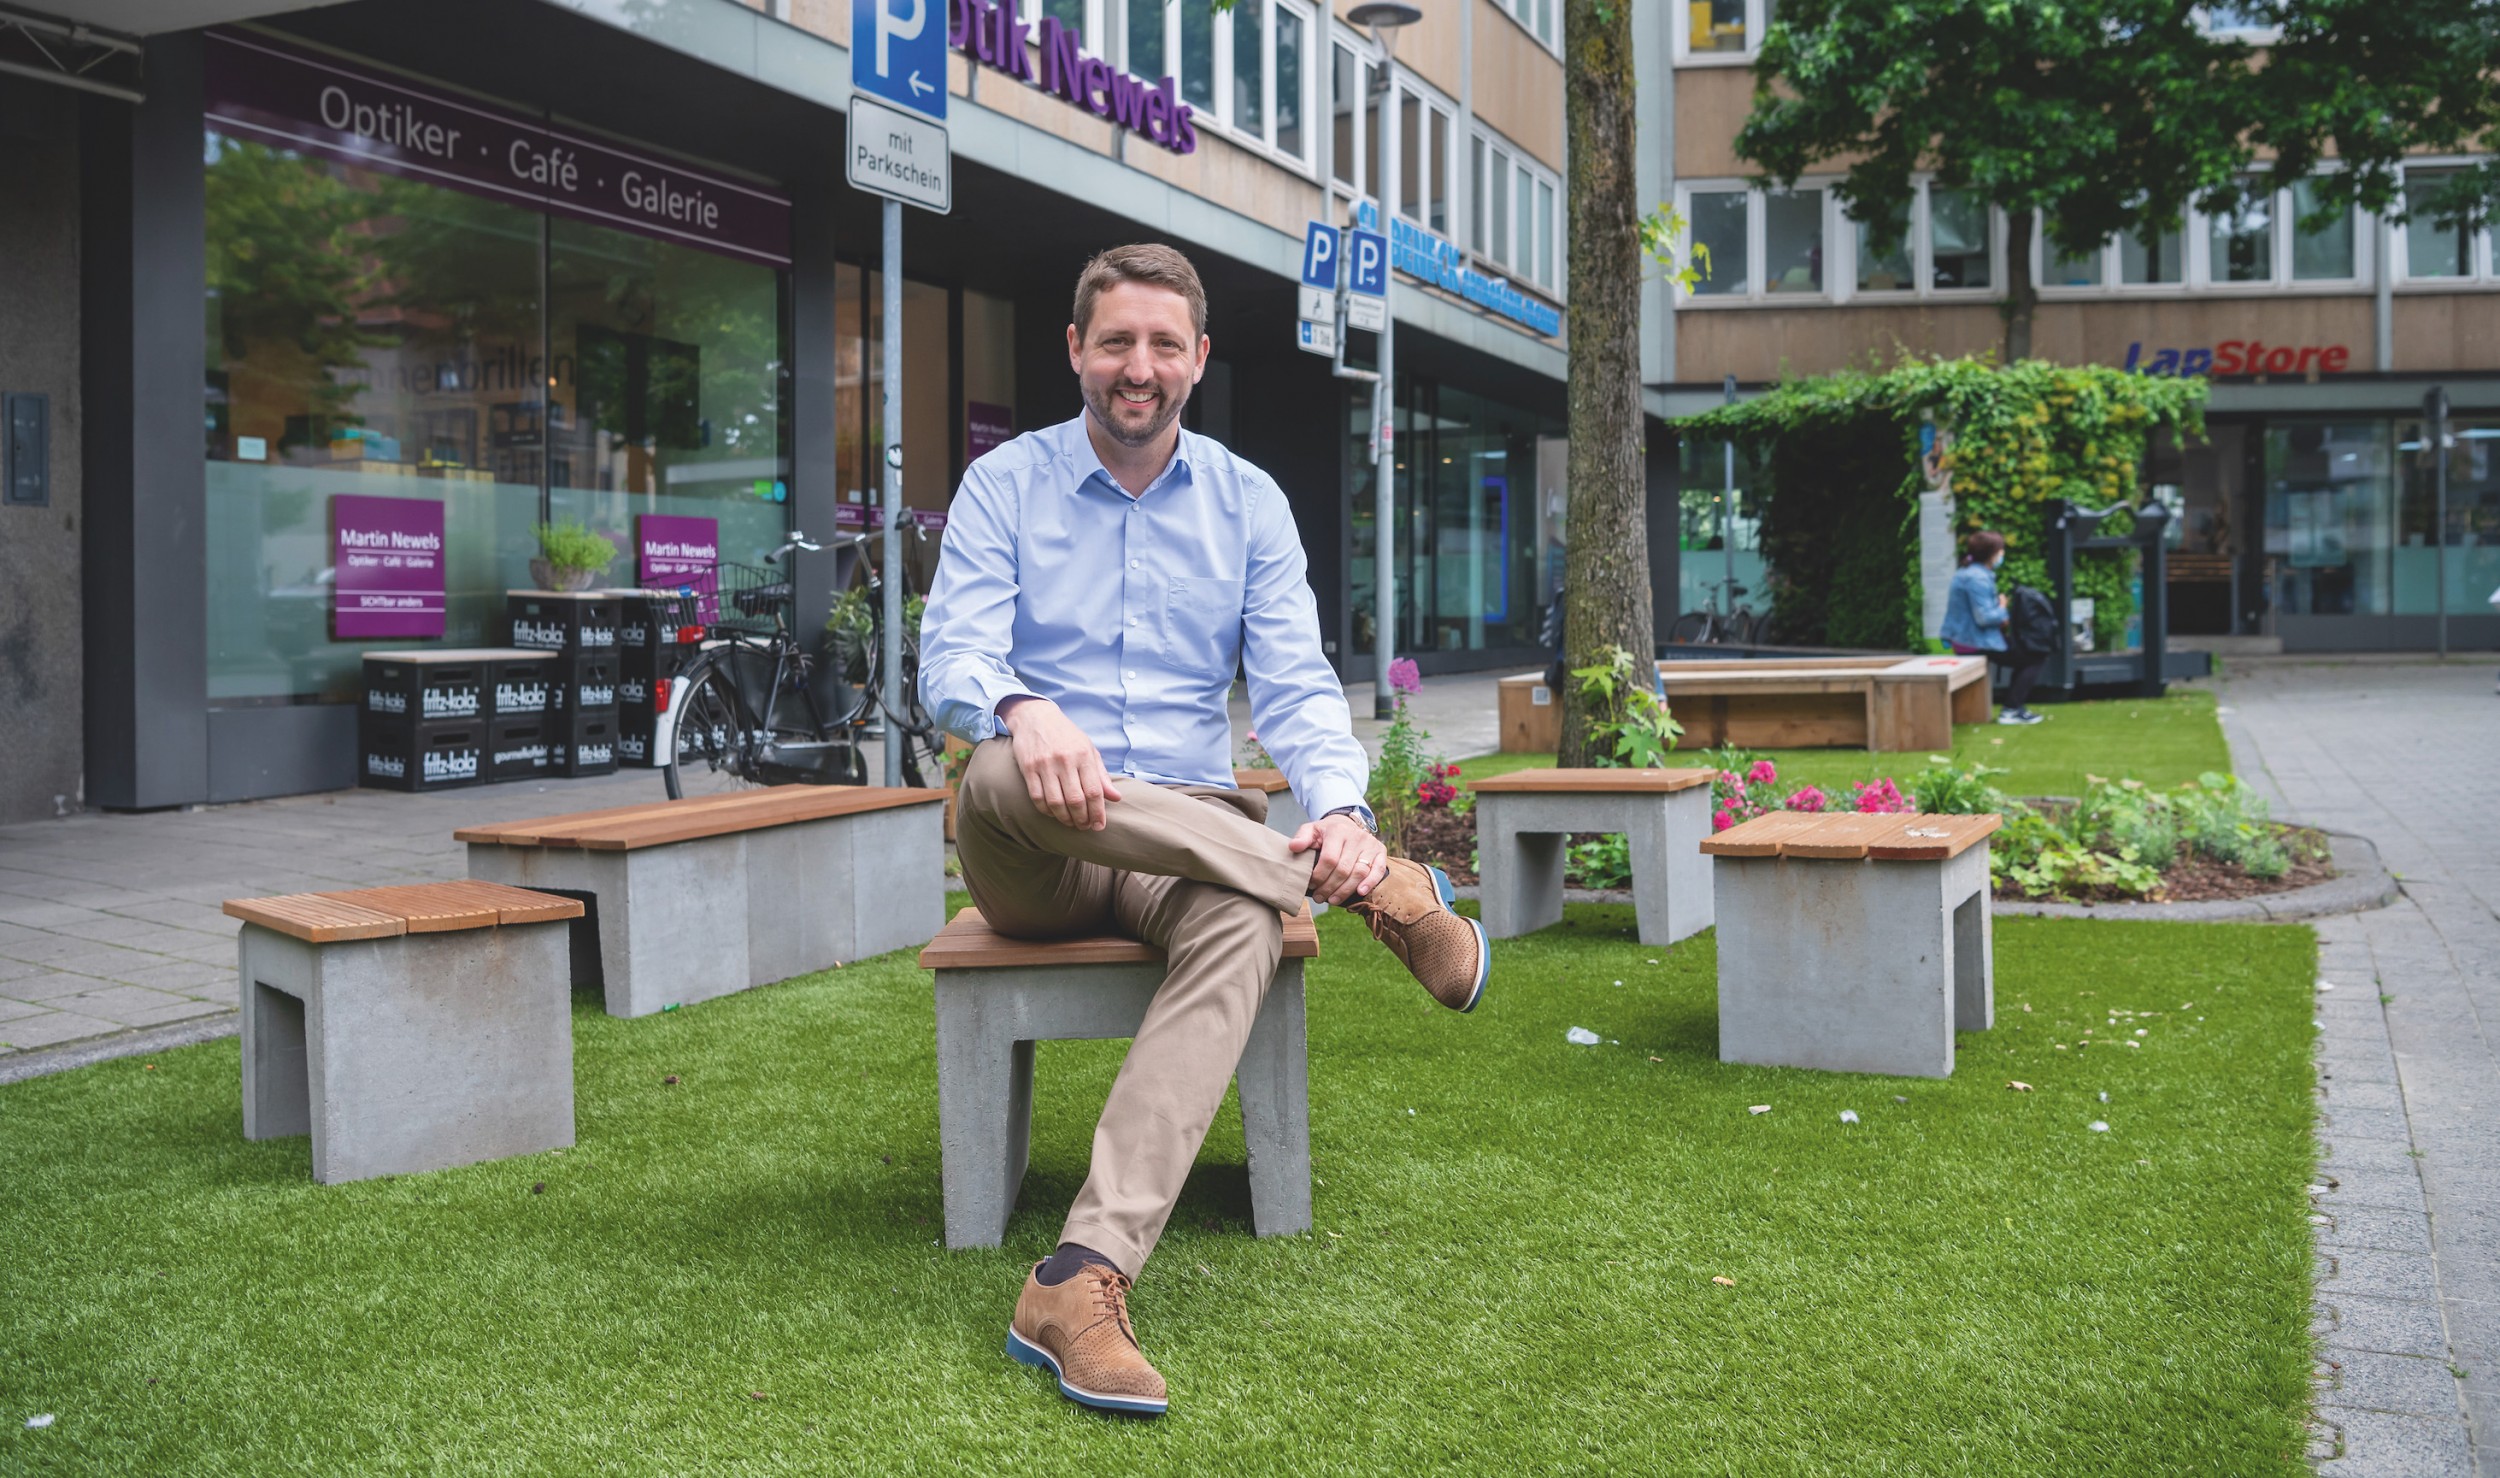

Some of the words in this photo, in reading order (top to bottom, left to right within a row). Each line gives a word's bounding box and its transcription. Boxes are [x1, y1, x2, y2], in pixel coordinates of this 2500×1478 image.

[1040, 15, 1196, 155] Newels
[889, 131, 912, 154] mit
[320, 86, 460, 160] Optiker
[509, 140, 578, 192] Café
[621, 171, 719, 229] Galerie
[857, 146, 942, 192] Parkschein
[1310, 230, 1331, 279] P
[1358, 239, 1379, 286] P
[2125, 340, 2349, 378] LapStore
[341, 528, 388, 548] Martin
[391, 530, 440, 550] Newels
[645, 541, 680, 557] Martin
[681, 543, 716, 559] Newels
[514, 619, 563, 644] fritz-kola
[423, 687, 477, 711] fritz-kola
[496, 682, 547, 707] fritz-kola
[423, 749, 477, 776] fritz-kola
